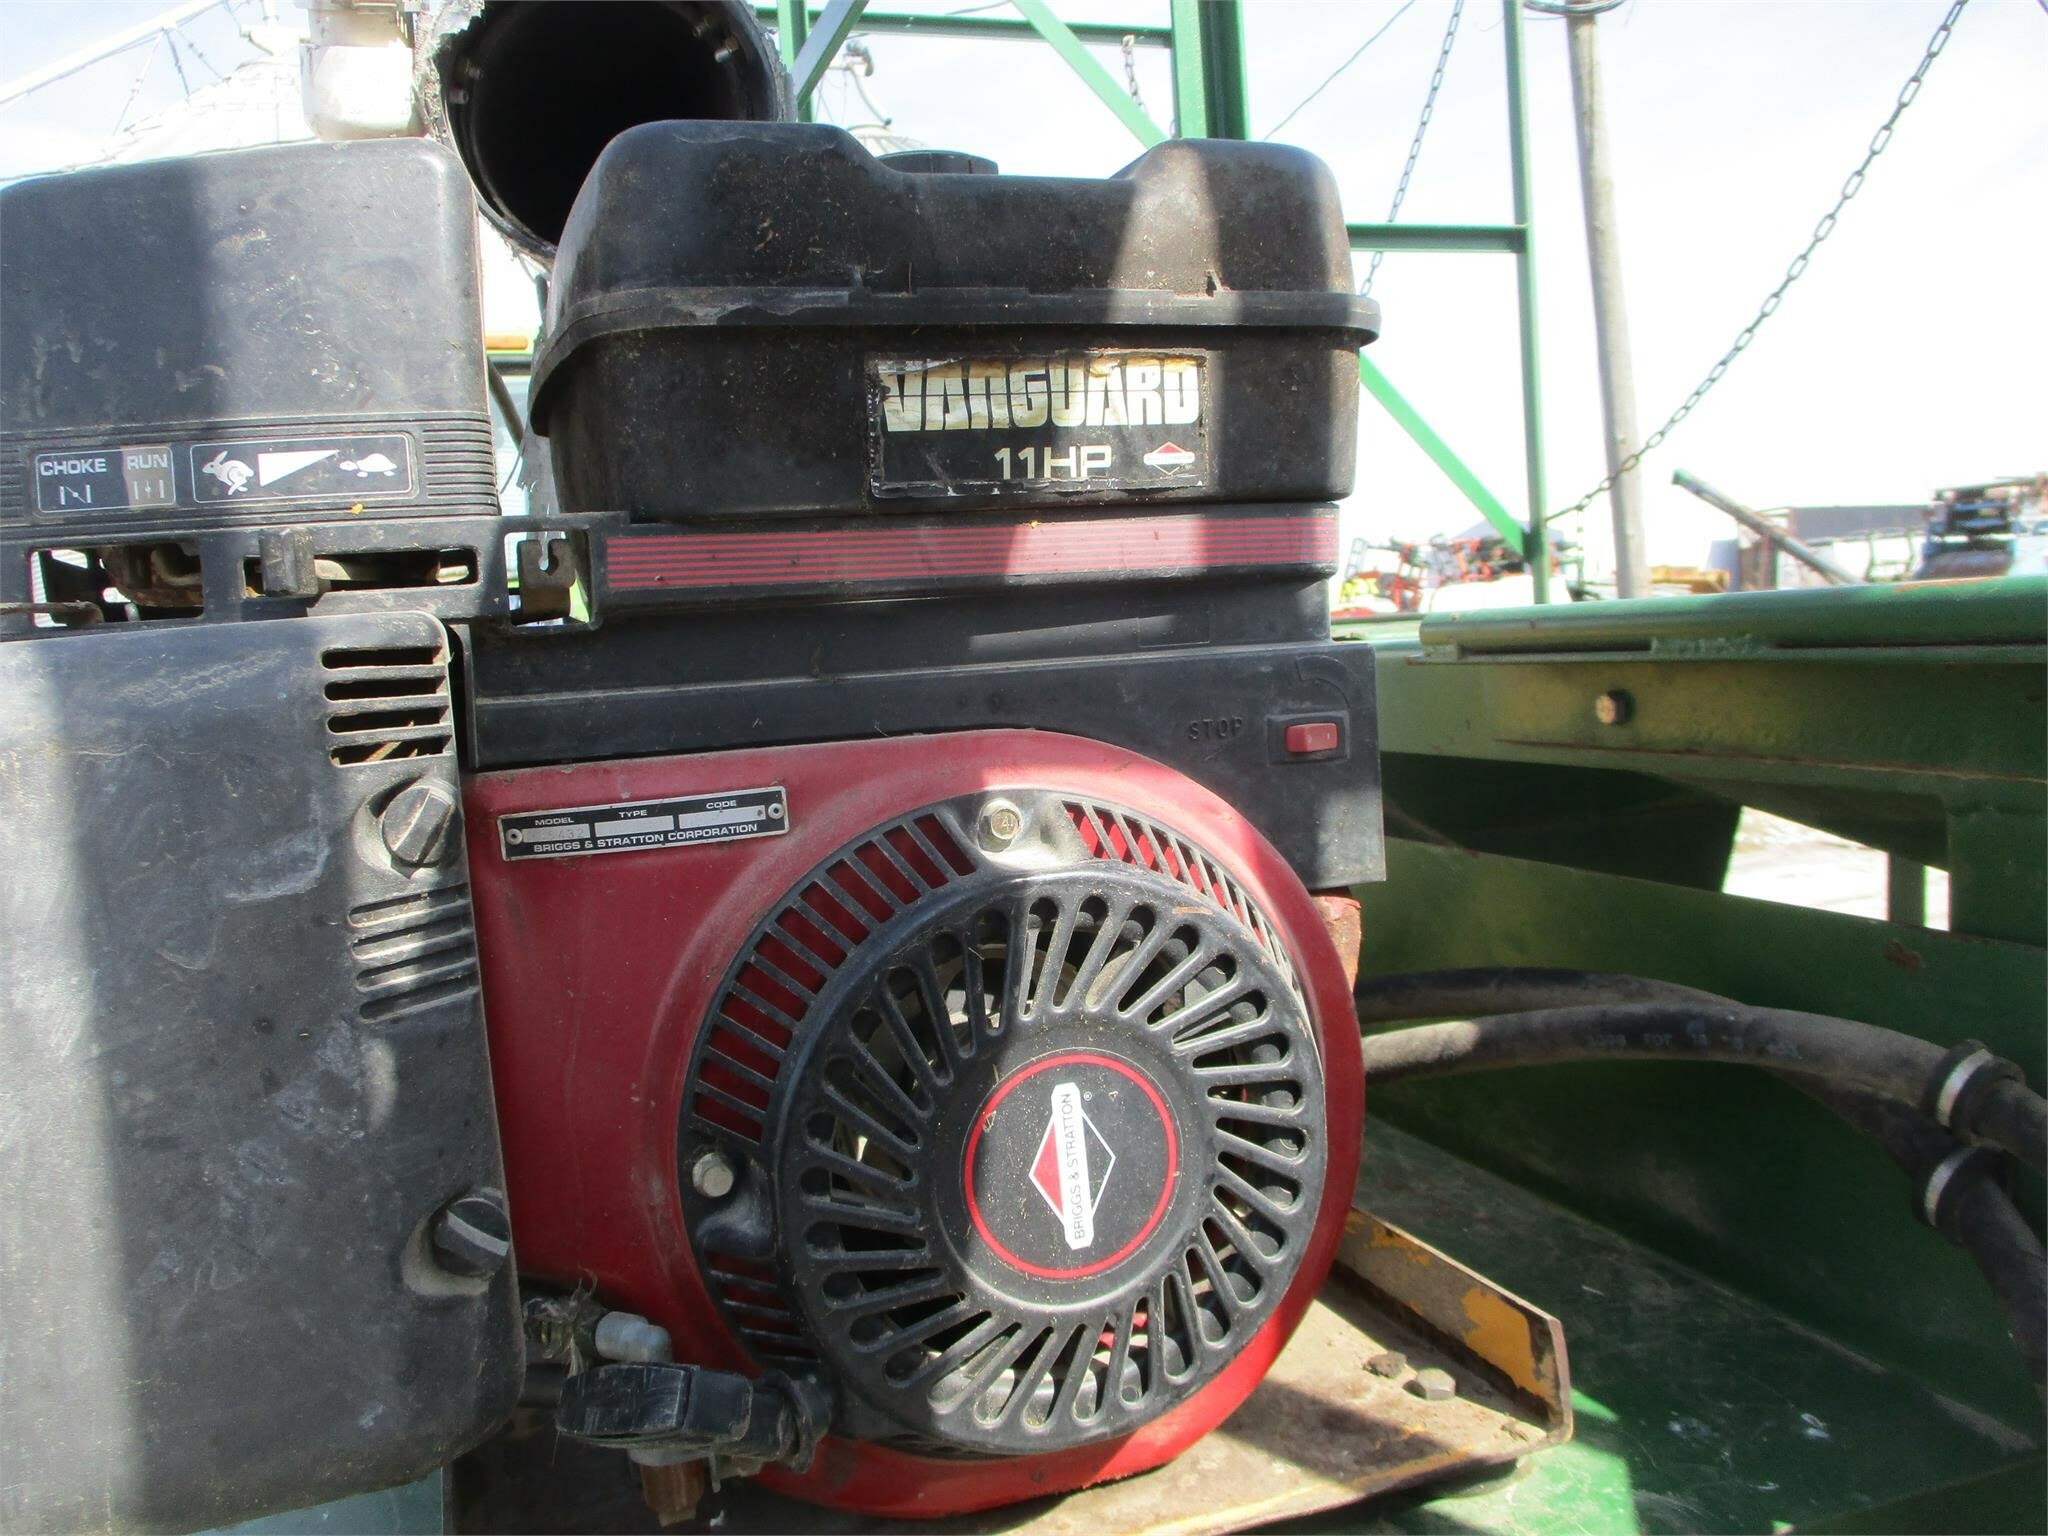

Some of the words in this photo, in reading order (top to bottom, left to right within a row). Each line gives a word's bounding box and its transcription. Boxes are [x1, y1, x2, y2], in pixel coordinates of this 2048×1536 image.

[881, 357, 1200, 432] VANGUARD
[40, 458, 107, 476] CHOKE
[127, 453, 168, 470] RUN
[1189, 717, 1243, 740] STOP
[535, 817, 575, 826] MODEL
[618, 809, 648, 818] TYPE
[706, 800, 737, 810] CODE
[533, 841, 581, 854] BRIGGS
[584, 839, 594, 849] &
[597, 833, 665, 848] STRATTON
[668, 823, 758, 842] CORPORATION
[1061, 1092, 1079, 1168] STRATTON
[1069, 1171, 1079, 1181] &
[1070, 1185, 1086, 1240] BRIGGS
